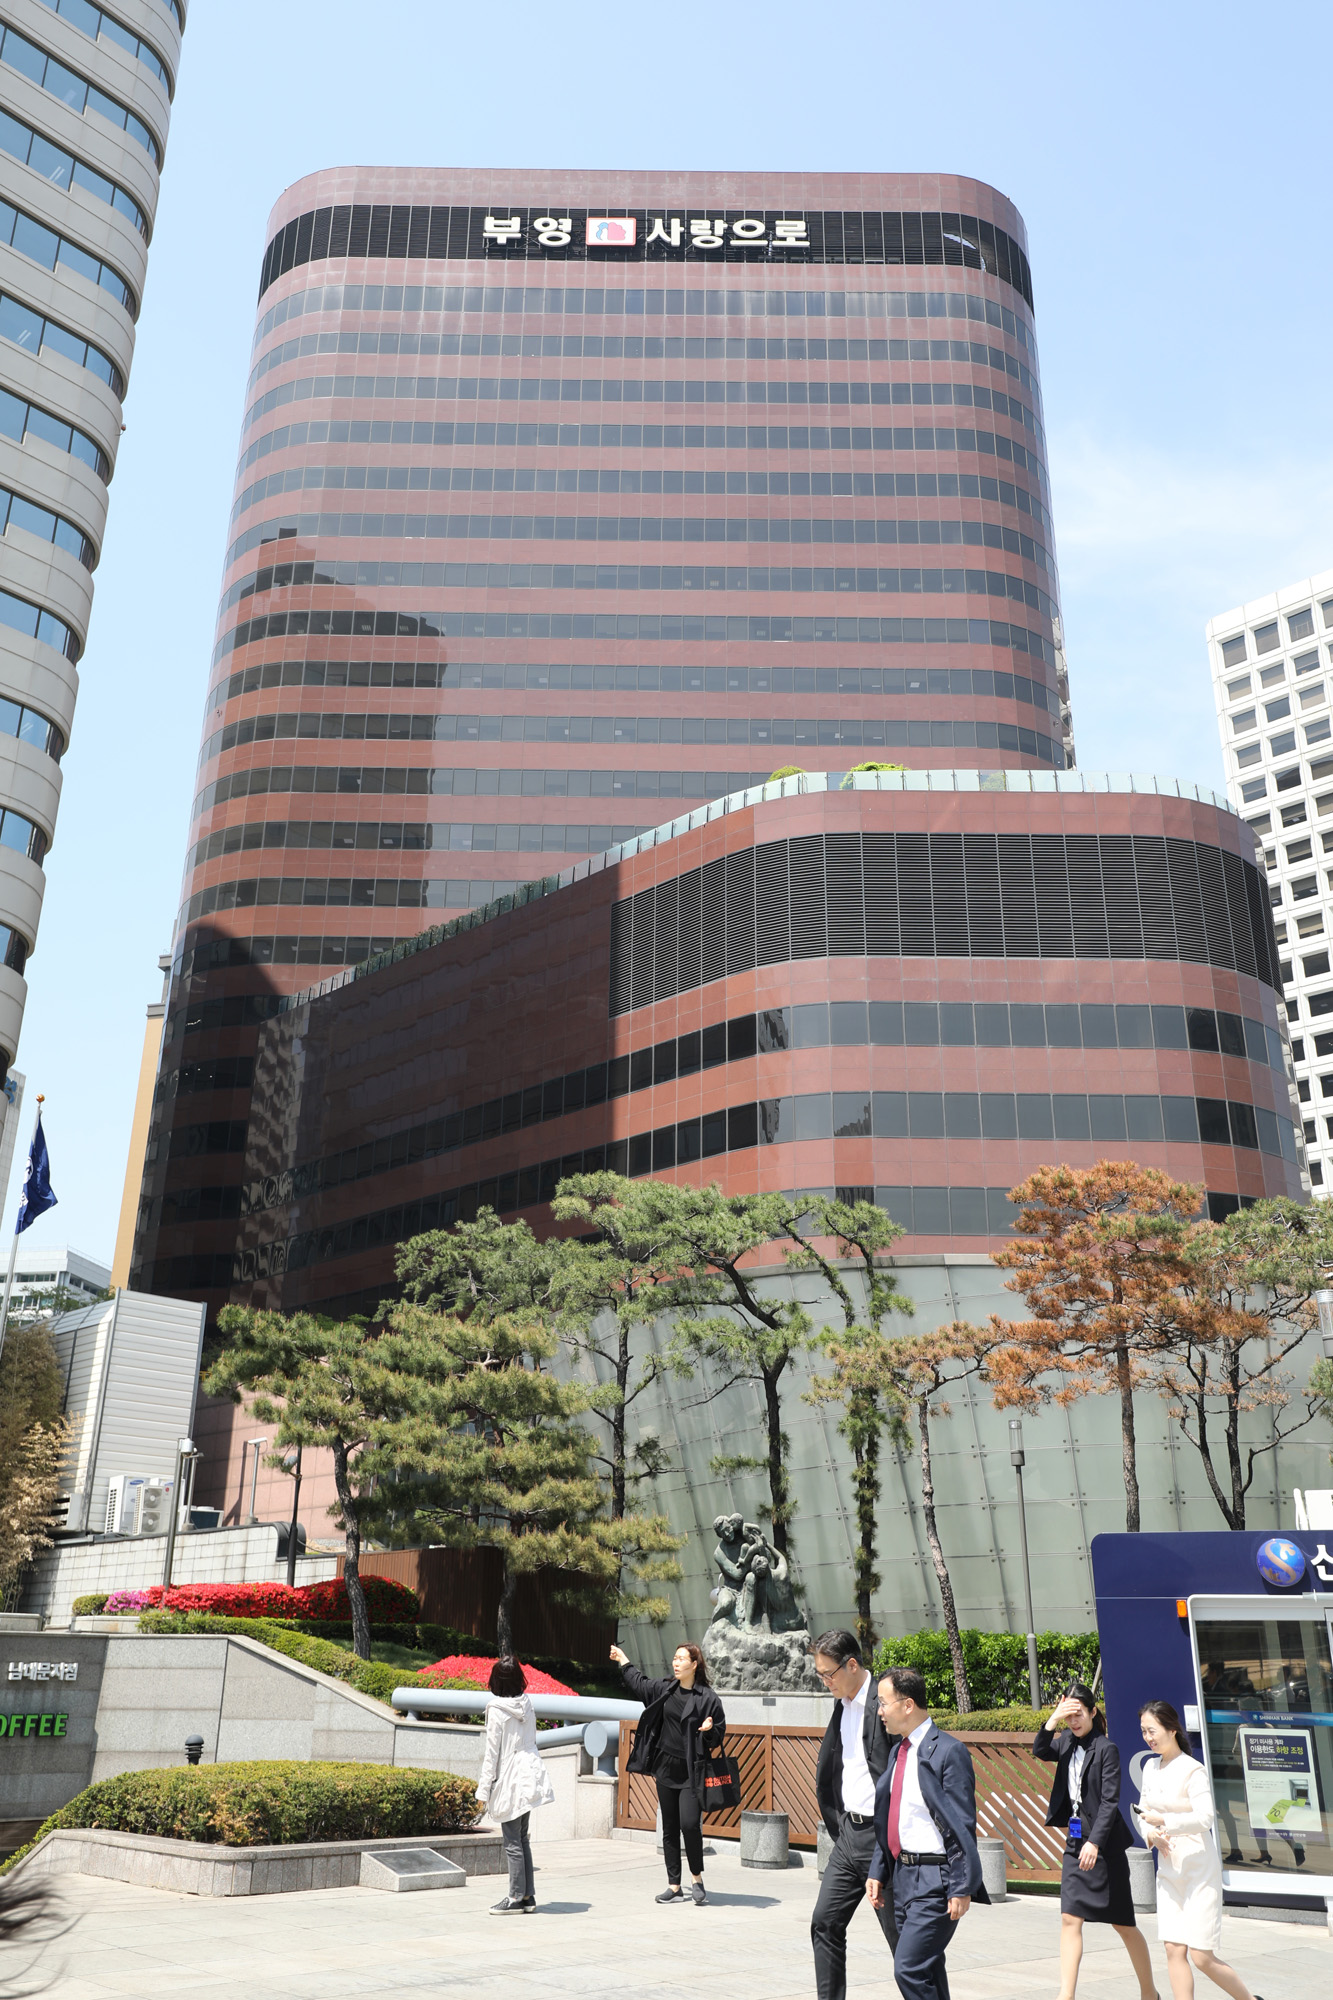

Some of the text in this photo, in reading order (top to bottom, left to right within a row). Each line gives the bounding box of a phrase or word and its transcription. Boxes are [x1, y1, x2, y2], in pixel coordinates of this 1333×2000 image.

[482, 216, 810, 249] 부영 사랑으로
[8, 1661, 79, 1681] 남대문지점
[1270, 1807, 1281, 1818] 70
